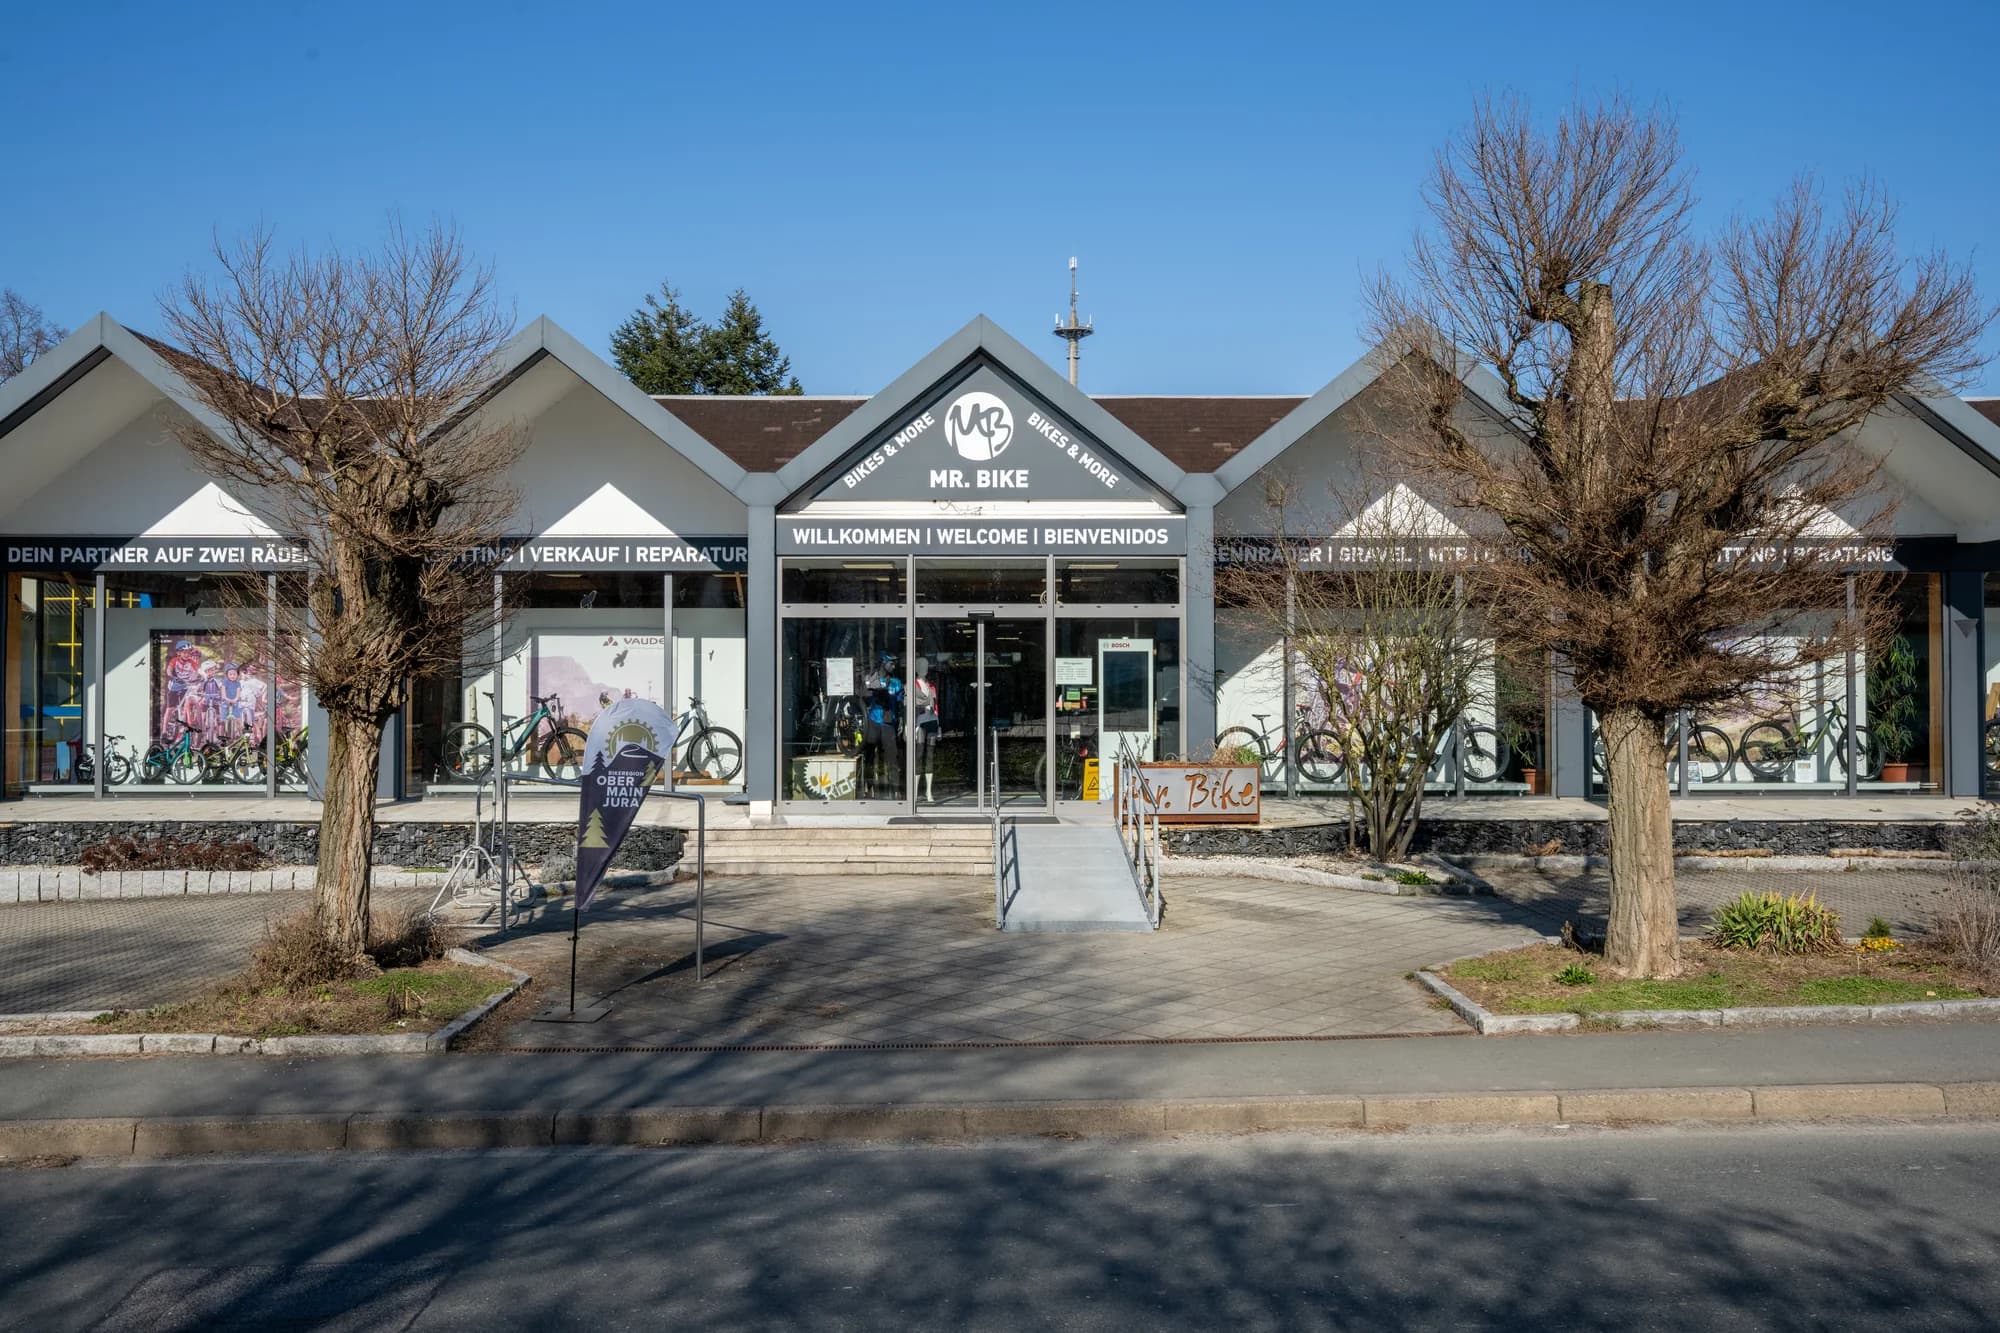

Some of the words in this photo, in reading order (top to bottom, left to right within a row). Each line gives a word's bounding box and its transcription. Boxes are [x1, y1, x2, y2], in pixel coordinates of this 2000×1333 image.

[843, 452, 885, 489] BIKES
[883, 444, 898, 457] &
[894, 411, 935, 448] MORE
[1027, 412, 1069, 449] BIKES
[1067, 444, 1079, 460] &
[1078, 452, 1119, 489] MORE
[930, 469, 970, 488] MR.
[976, 469, 1029, 488] BIKE
[792, 528, 920, 545] WILLKOMMEN
[937, 528, 1028, 545] WELCOME
[1044, 528, 1169, 545] BIENVENIDOS
[8, 547, 54, 563] DEIN
[60, 547, 149, 563] PARTNER
[154, 547, 194, 563] AUF
[198, 547, 245, 563] ZWEI
[251, 543, 308, 563] RÄDE
[530, 546, 620, 563] VERKAUF
[636, 546, 748, 563] REPARATUR
[1339, 546, 1404, 563] GRAVEL
[596, 775, 635, 786] OBER
[606, 786, 644, 797] MAIN
[1184, 768, 1256, 812] Bike
[602, 797, 640, 807] JURA
